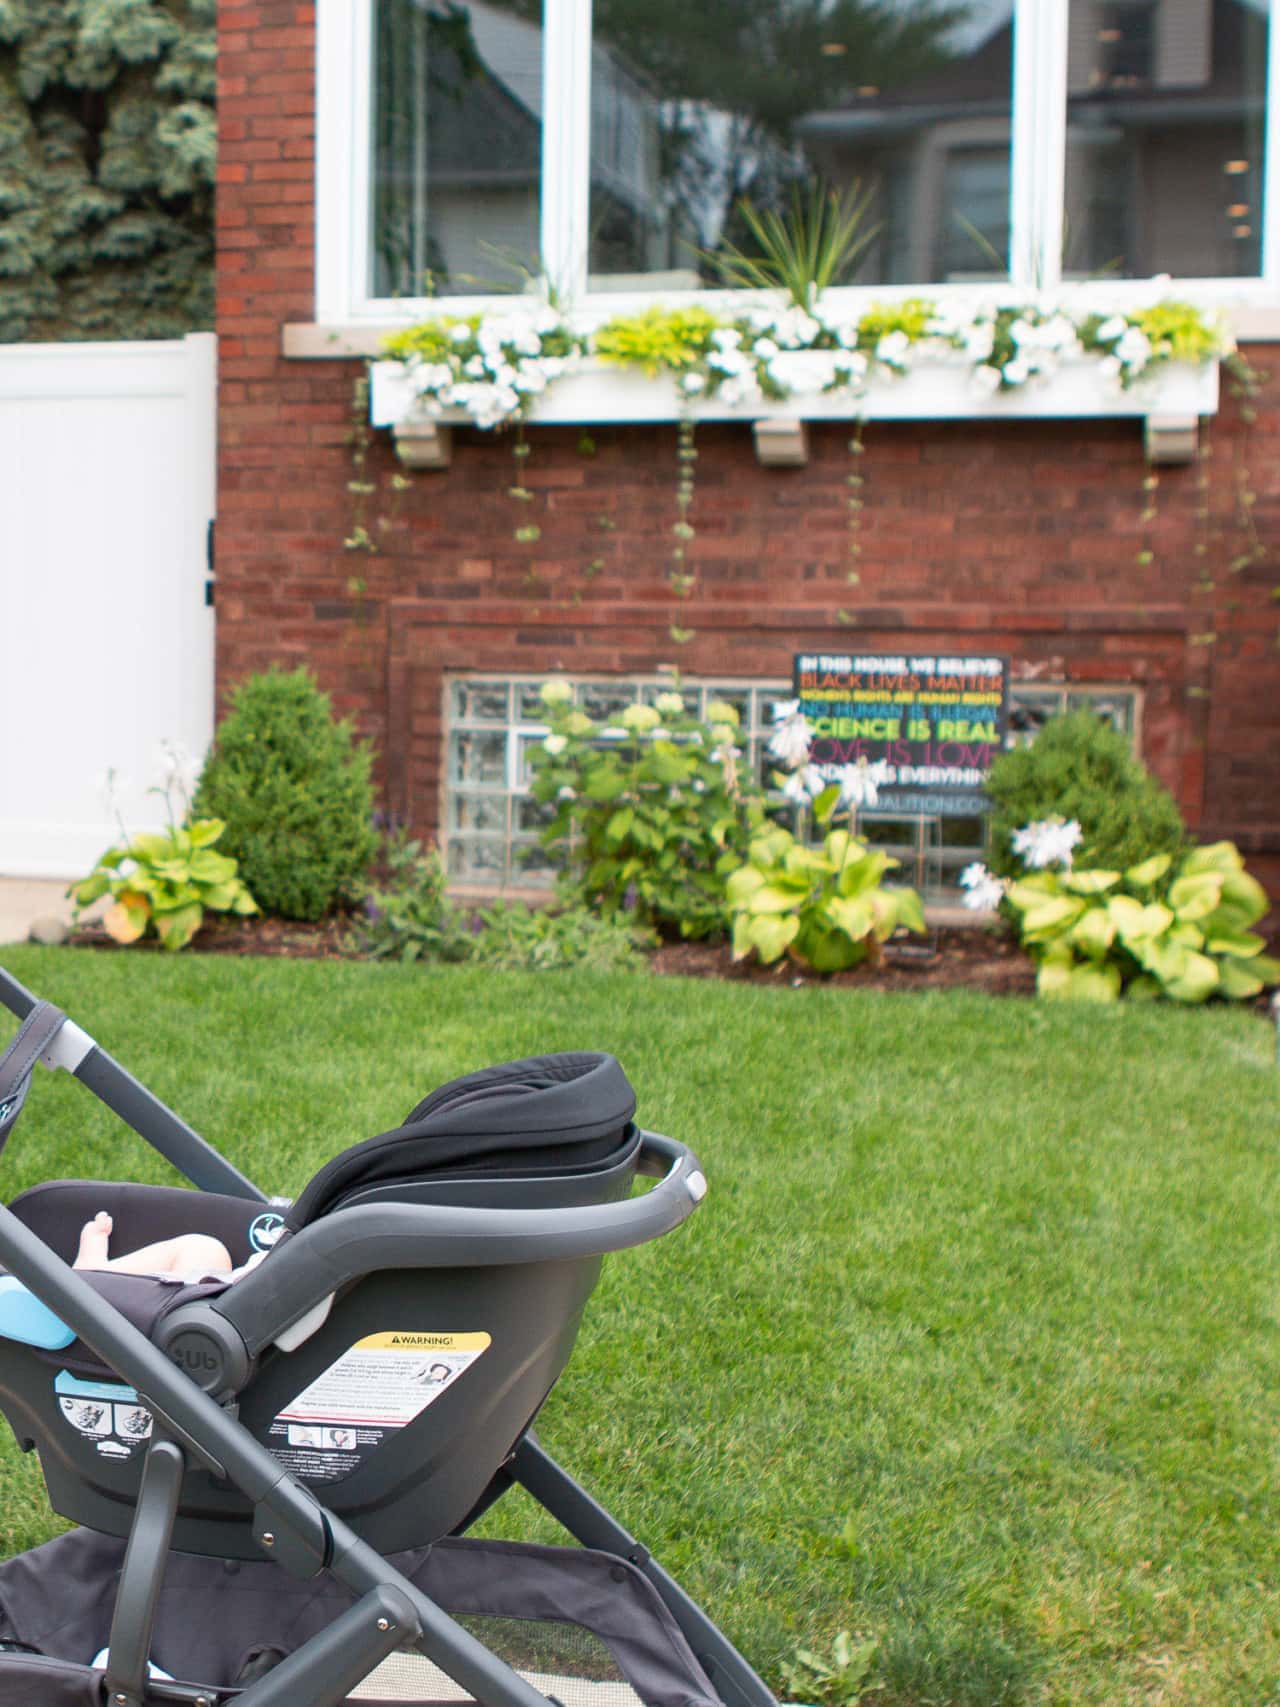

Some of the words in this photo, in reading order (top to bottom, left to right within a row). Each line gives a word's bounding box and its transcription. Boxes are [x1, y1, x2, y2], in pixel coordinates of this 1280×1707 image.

[799, 657, 817, 673] IN
[819, 657, 852, 674] THIS
[854, 657, 908, 676] HOUSE,
[910, 658, 934, 675] WE
[800, 673, 861, 690] BLACK
[869, 674, 920, 690] LIVES
[927, 675, 1003, 691] MATTER
[853, 690, 892, 703] RIGHTS
[894, 690, 915, 704] ARE
[918, 691, 960, 705] HUMAN
[962, 691, 1002, 705] RIGHTS
[799, 702, 829, 717] NO
[833, 703, 904, 718] HUMAN
[910, 703, 926, 719] IS
[929, 704, 998, 720] ILLEGAL
[908, 718, 931, 741] IS
[937, 720, 1001, 742] REAL
[809, 739, 870, 763] OVE
[885, 739, 911, 765] IS
[898, 766, 991, 785] EVERYTHIN
[401, 1336, 453, 1346] WARNING!
